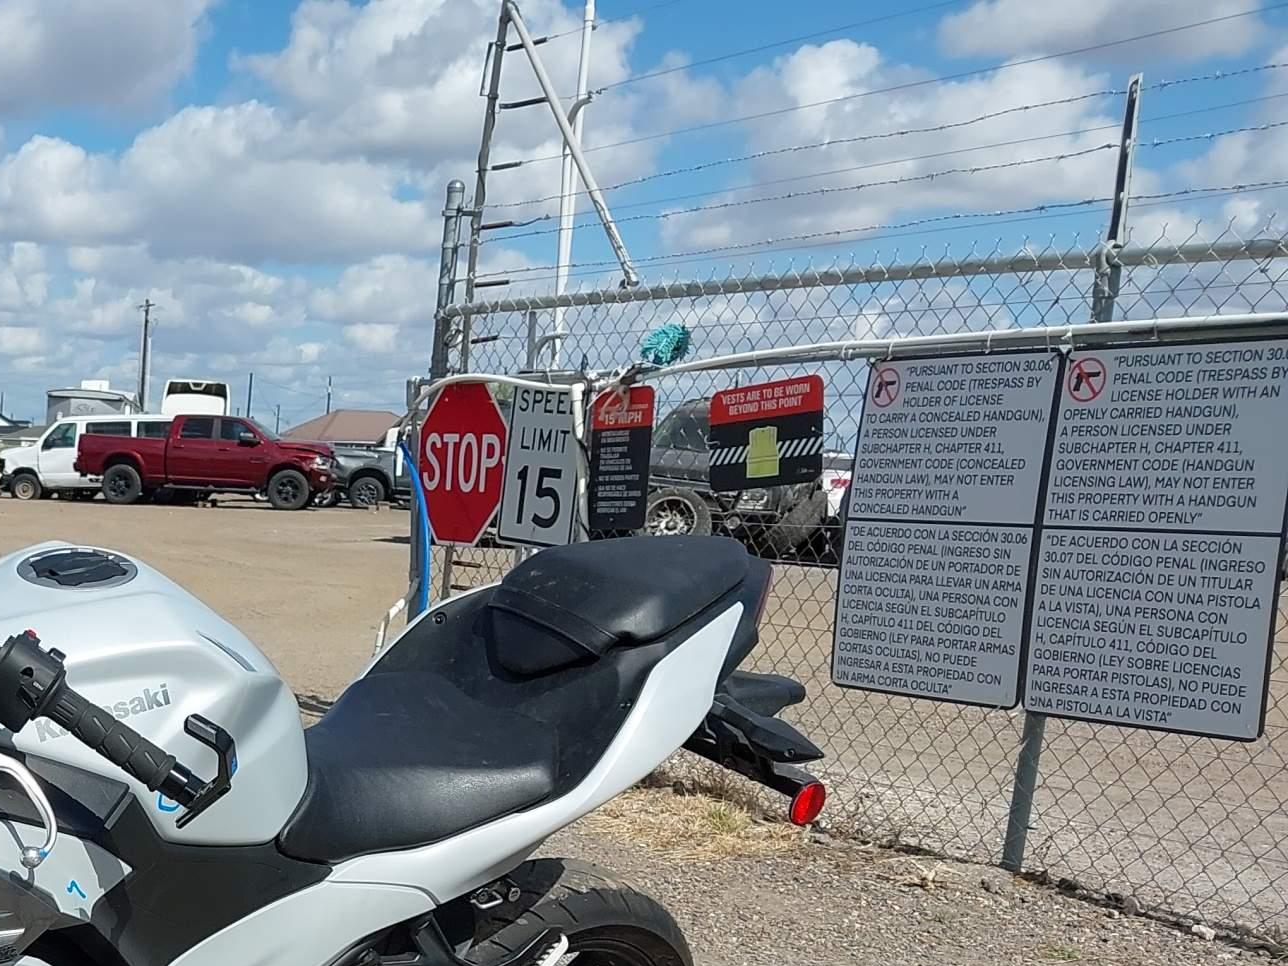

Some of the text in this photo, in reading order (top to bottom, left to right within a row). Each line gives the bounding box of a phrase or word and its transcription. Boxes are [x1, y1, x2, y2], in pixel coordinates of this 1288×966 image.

[1185, 351, 1203, 365] TO
[1204, 349, 1264, 364] SECTION
[1266, 345, 1288, 361] 30.
[961, 362, 974, 375] TO
[975, 360, 1021, 374] SECTION
[1113, 364, 1288, 385] PENAL CODE (TRESPASS BY
[904, 375, 1042, 393] PENAL CODE (TRESPASS BY
[1110, 384, 1280, 402] LICENSE HOLDER WITH AN
[519, 389, 574, 415] SPEE
[721, 383, 810, 405] VESTS ARE TO BE WORN
[902, 393, 1004, 408] HOLDER OF LICENSE
[728, 395, 803, 416] BEYOND THIS POINT
[1063, 407, 1108, 421] OPENLY
[1109, 406, 1163, 419] CARRIED
[604, 411, 642, 425] 15 MPH
[865, 412, 878, 424] TO
[878, 412, 910, 424] CARRY
[909, 411, 917, 423] A
[918, 410, 981, 423] CONCEALED
[863, 426, 997, 439] A PERSON LICENSED UNDER
[1059, 422, 1232, 438] A PERSON LICENSED UNDER
[520, 426, 570, 453] LIMIT
[861, 442, 922, 454] SUBCHAPTER
[934, 442, 982, 454] CHAPTER
[1057, 441, 1137, 454] SUBCHAPTER
[1154, 440, 1214, 454] CHAPTER
[422, 432, 501, 493] STOP
[859, 458, 1026, 471] GOVERNMENT CODE (CONCEALED
[1055, 458, 1255, 473] GOVERNMENT CODE (HANDGUN
[856, 473, 903, 486] HANDGUN
[933, 473, 955, 485] MAY
[956, 474, 978, 486] NOT
[979, 474, 1014, 486] ENTER
[1053, 475, 1116, 488] LICENSING
[1154, 476, 1181, 489] MAY
[1182, 476, 1210, 489] NOT
[1212, 476, 1255, 490] ENTER
[516, 465, 562, 529] 15
[854, 487, 959, 501] THIS PROPERTY WITH A
[1050, 491, 1257, 508] THIS PROPERTY WITH A HANDGUN
[852, 502, 910, 515] CONCEALED
[1048, 508, 1077, 520] THAT
[1078, 509, 1090, 522] IS
[1092, 509, 1145, 523] CARRIED
[866, 526, 912, 539] ACUERDO
[913, 528, 936, 540] CON
[937, 529, 950, 541] LA
[951, 530, 999, 543] SECCIÓN
[1000, 532, 1028, 545] 30.06
[1068, 535, 1129, 549] ACUERDO
[1131, 537, 1160, 551] CON
[1163, 539, 1179, 552] LA
[1181, 539, 1242, 554] SECCIÓN
[845, 555, 1021, 577] AUTORIZACIÓN DE UN PORTADOR DE
[1043, 550, 1266, 574] 30.07 DEL CÓDIGO PENAL (INGRESO
[1041, 567, 1253, 591] SIN AUTORIZACIÓN DE UN TITULAR
[842, 598, 1006, 623] LICENCIA SEGÚN EL SUBCAPÍTULO
[1036, 615, 1247, 644] LICENCIA SEGÚN EL SUBCAPÍTULO
[839, 627, 1015, 656] GOBIERNO (LEY PARA PORTAR ARMAS
[1031, 680, 1241, 714] INGRESAR A ESTA PROPIEDAD CON
[34, 683, 171, 743] Ksaki
